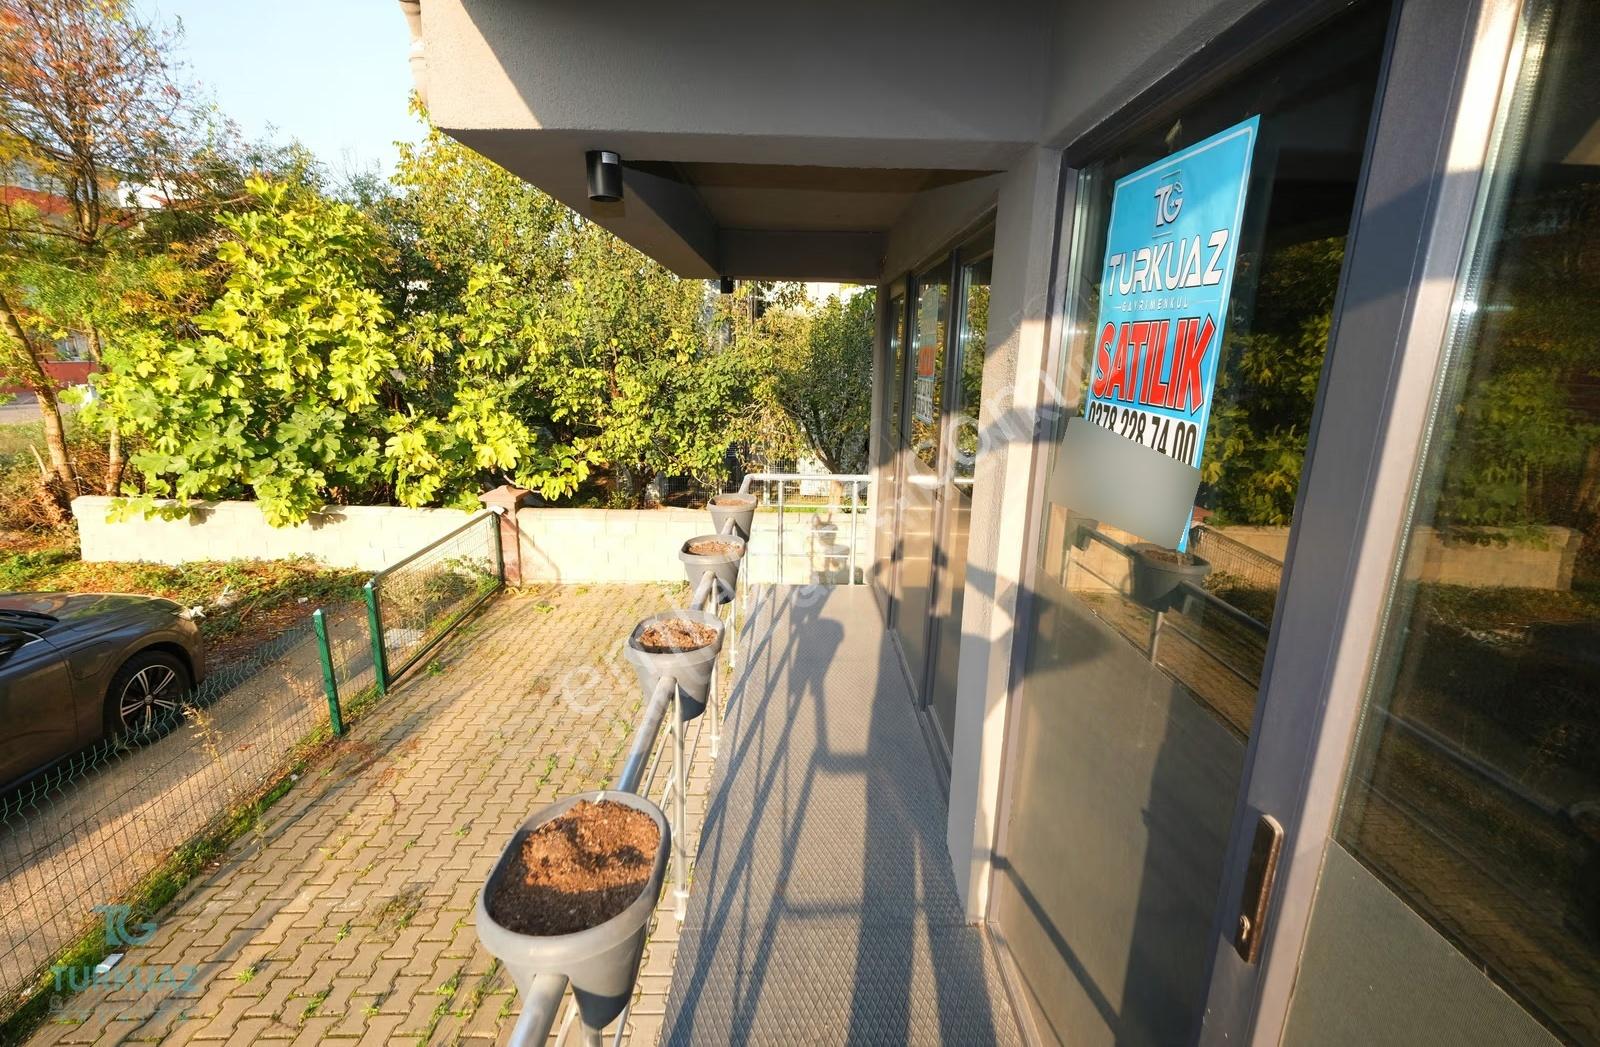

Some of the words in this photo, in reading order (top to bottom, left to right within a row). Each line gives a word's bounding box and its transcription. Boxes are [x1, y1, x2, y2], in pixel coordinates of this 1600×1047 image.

[1154, 182, 1184, 227] TG
[1107, 228, 1230, 296] TURKUAZ
[1091, 311, 1217, 416] SATILIK
